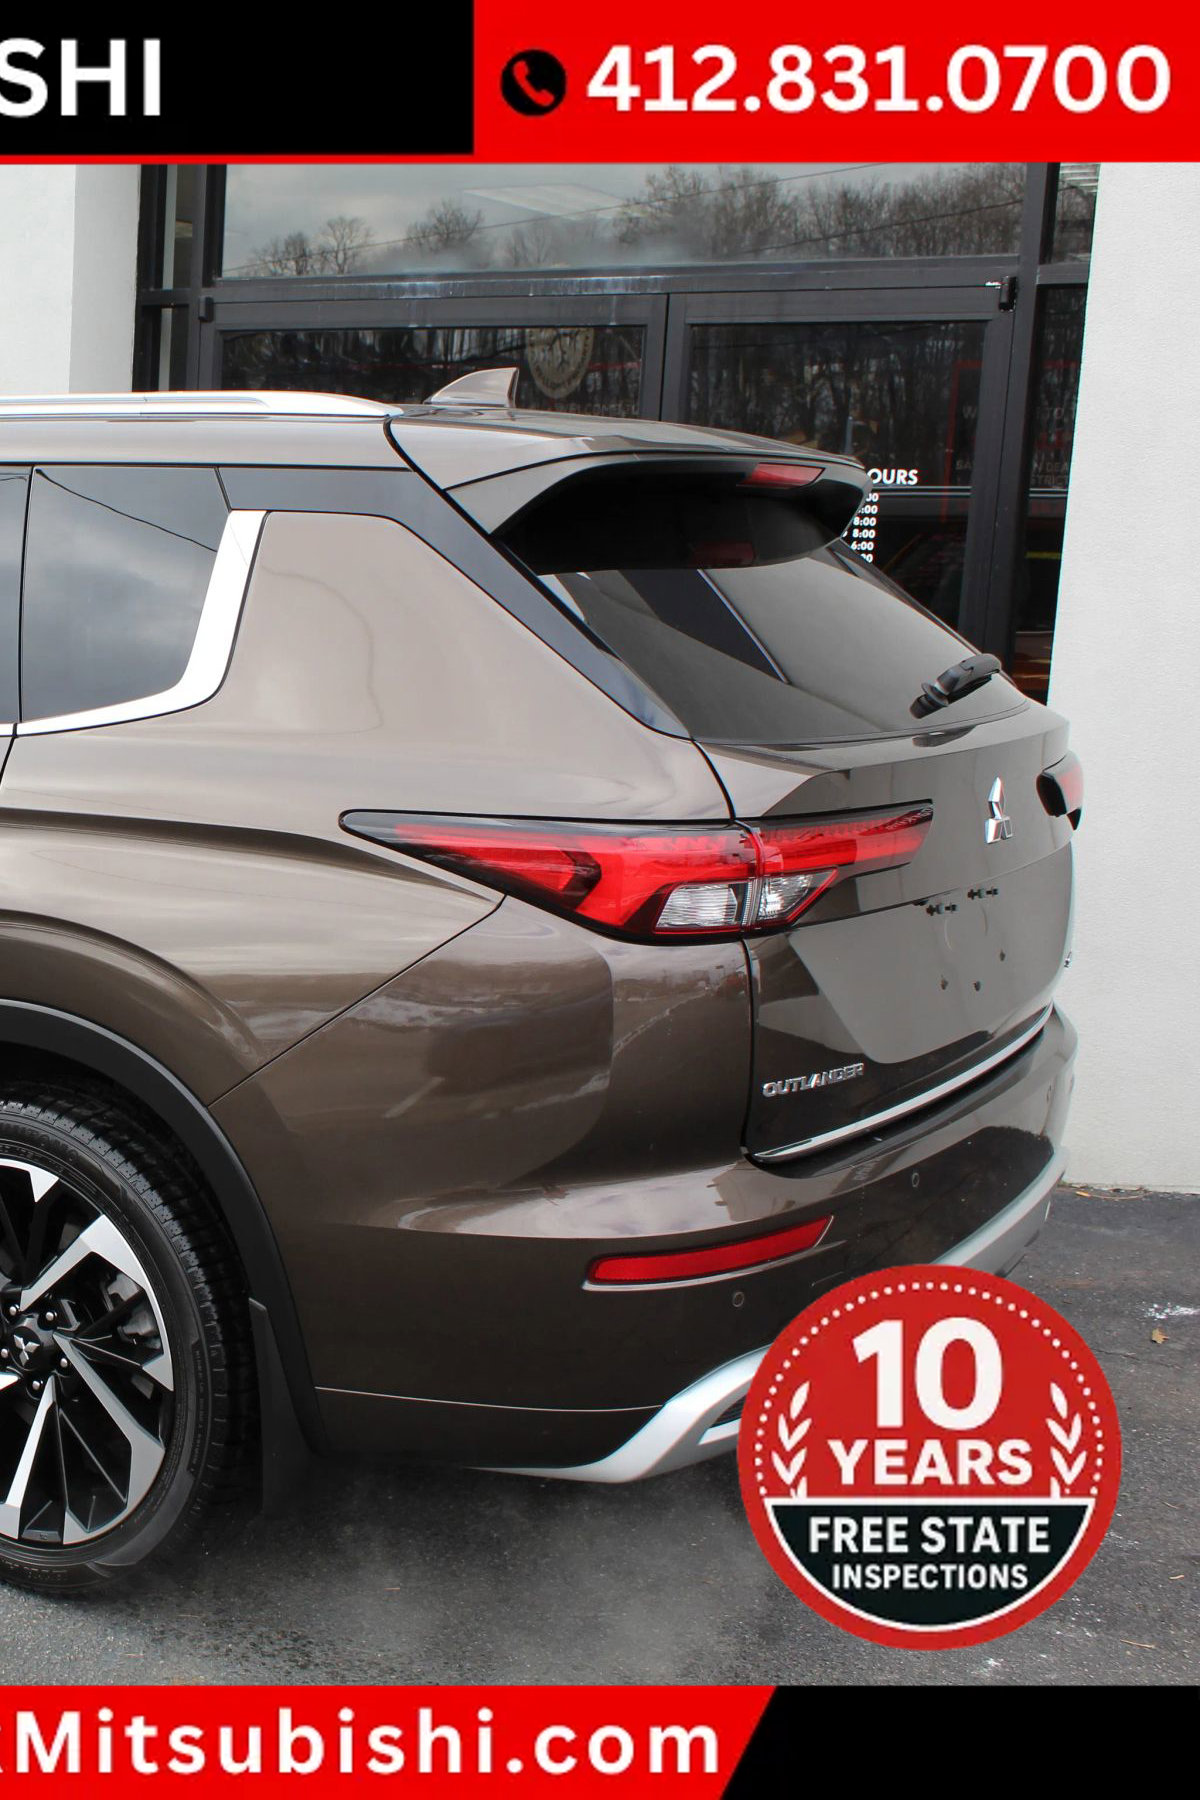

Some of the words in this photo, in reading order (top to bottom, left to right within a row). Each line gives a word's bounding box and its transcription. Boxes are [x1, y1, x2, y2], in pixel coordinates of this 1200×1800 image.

[853, 516, 877, 526] 8:00
[852, 529, 876, 539] 8:00
[850, 541, 874, 551] 6:00
[763, 1062, 864, 1098] OUTLANDER
